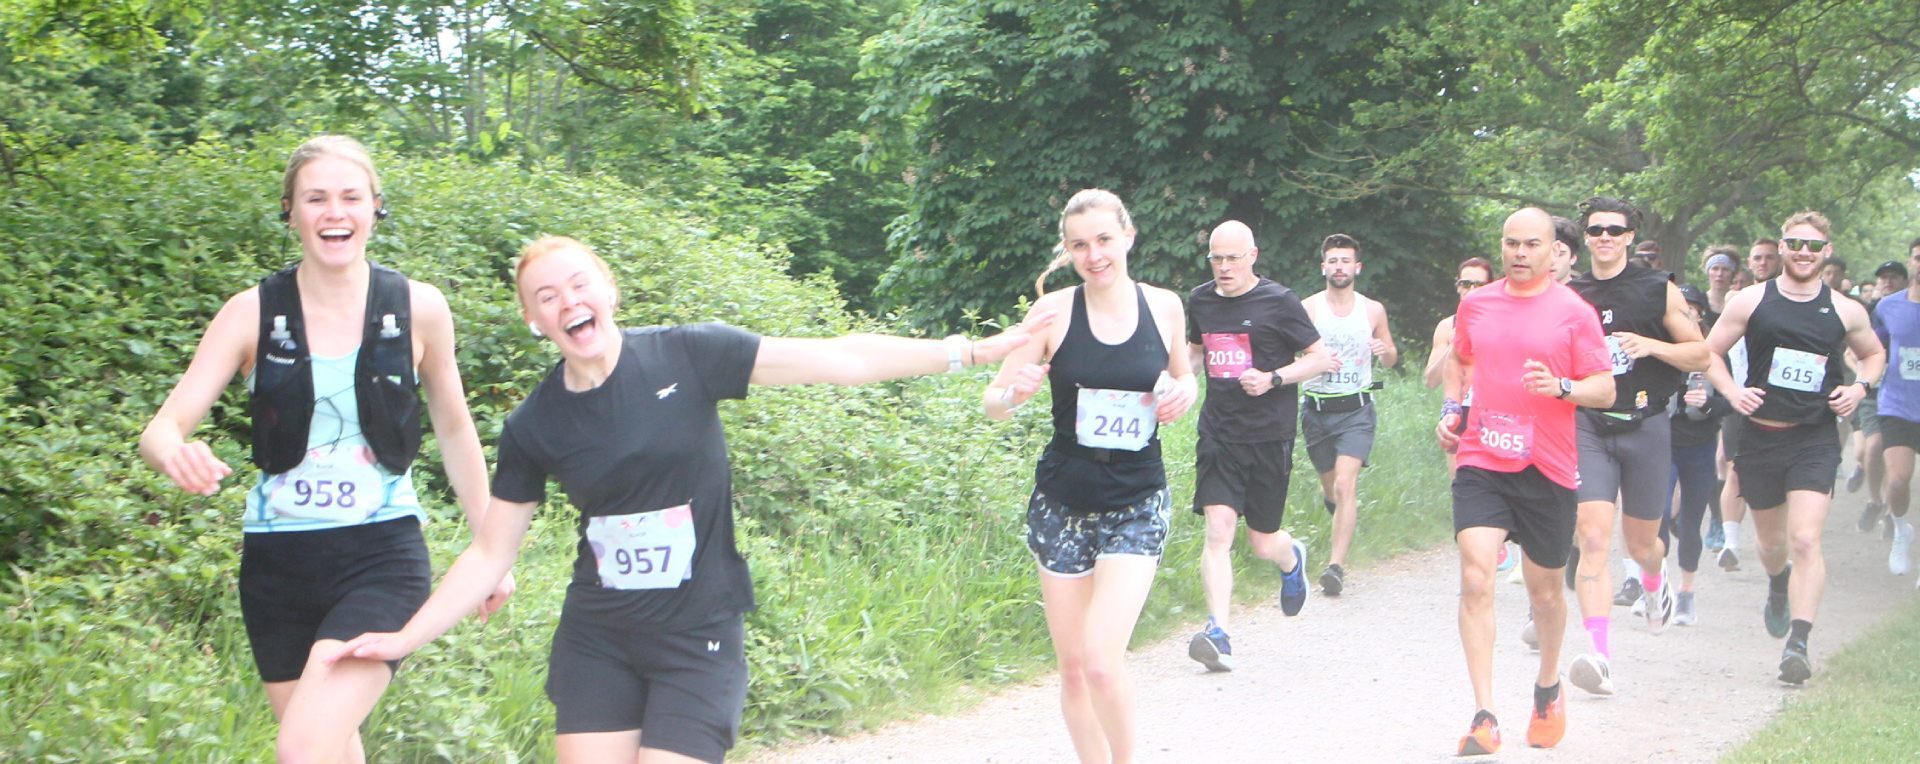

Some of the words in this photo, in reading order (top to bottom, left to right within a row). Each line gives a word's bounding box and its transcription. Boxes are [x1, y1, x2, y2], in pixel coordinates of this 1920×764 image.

[1209, 350, 1247, 366] 2019
[1327, 372, 1358, 384] 1150
[1782, 366, 1813, 384] 615
[1093, 415, 1141, 438] 244
[1480, 427, 1524, 451] 2065
[293, 479, 357, 508] 958
[615, 545, 673, 575] 957
